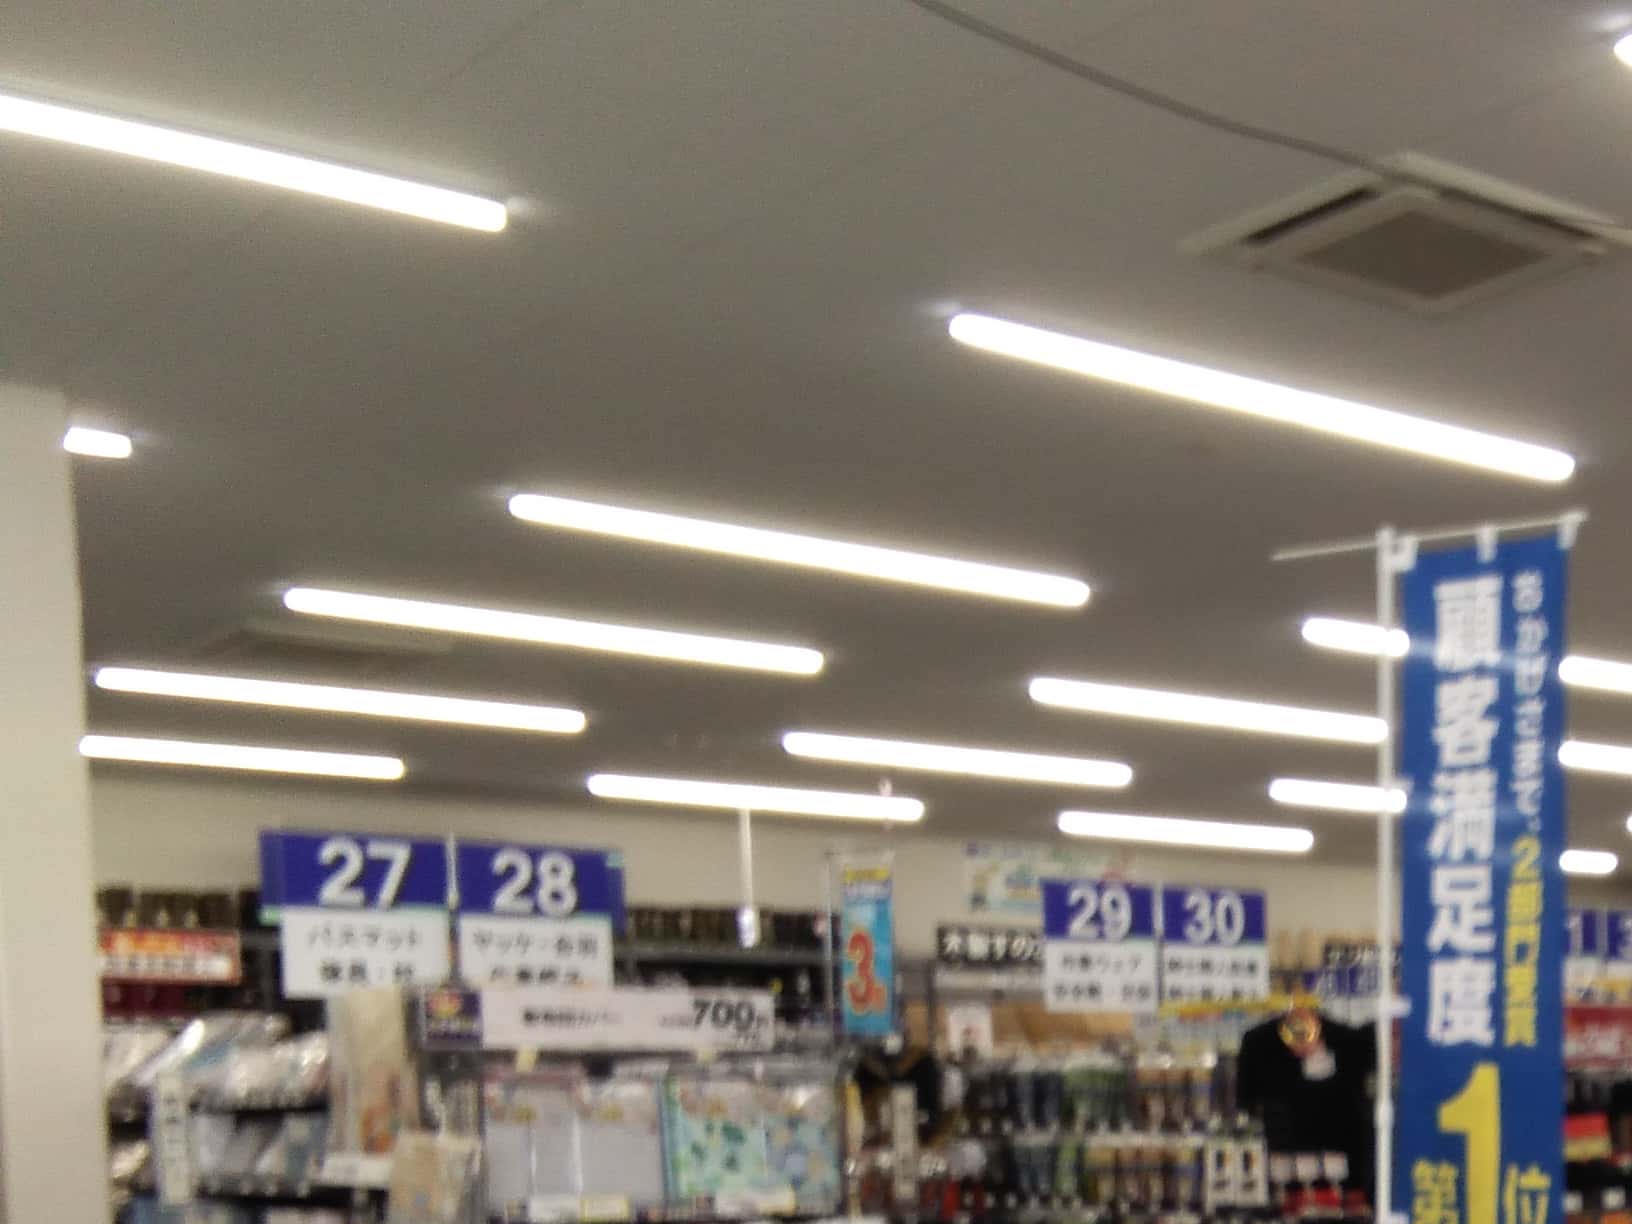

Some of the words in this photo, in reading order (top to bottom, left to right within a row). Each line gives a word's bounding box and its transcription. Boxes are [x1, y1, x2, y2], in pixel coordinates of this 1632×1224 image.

[316, 837, 412, 909] 27
[491, 849, 579, 918] 28
[1067, 886, 1134, 940] 29
[1184, 890, 1246, 945] 30
